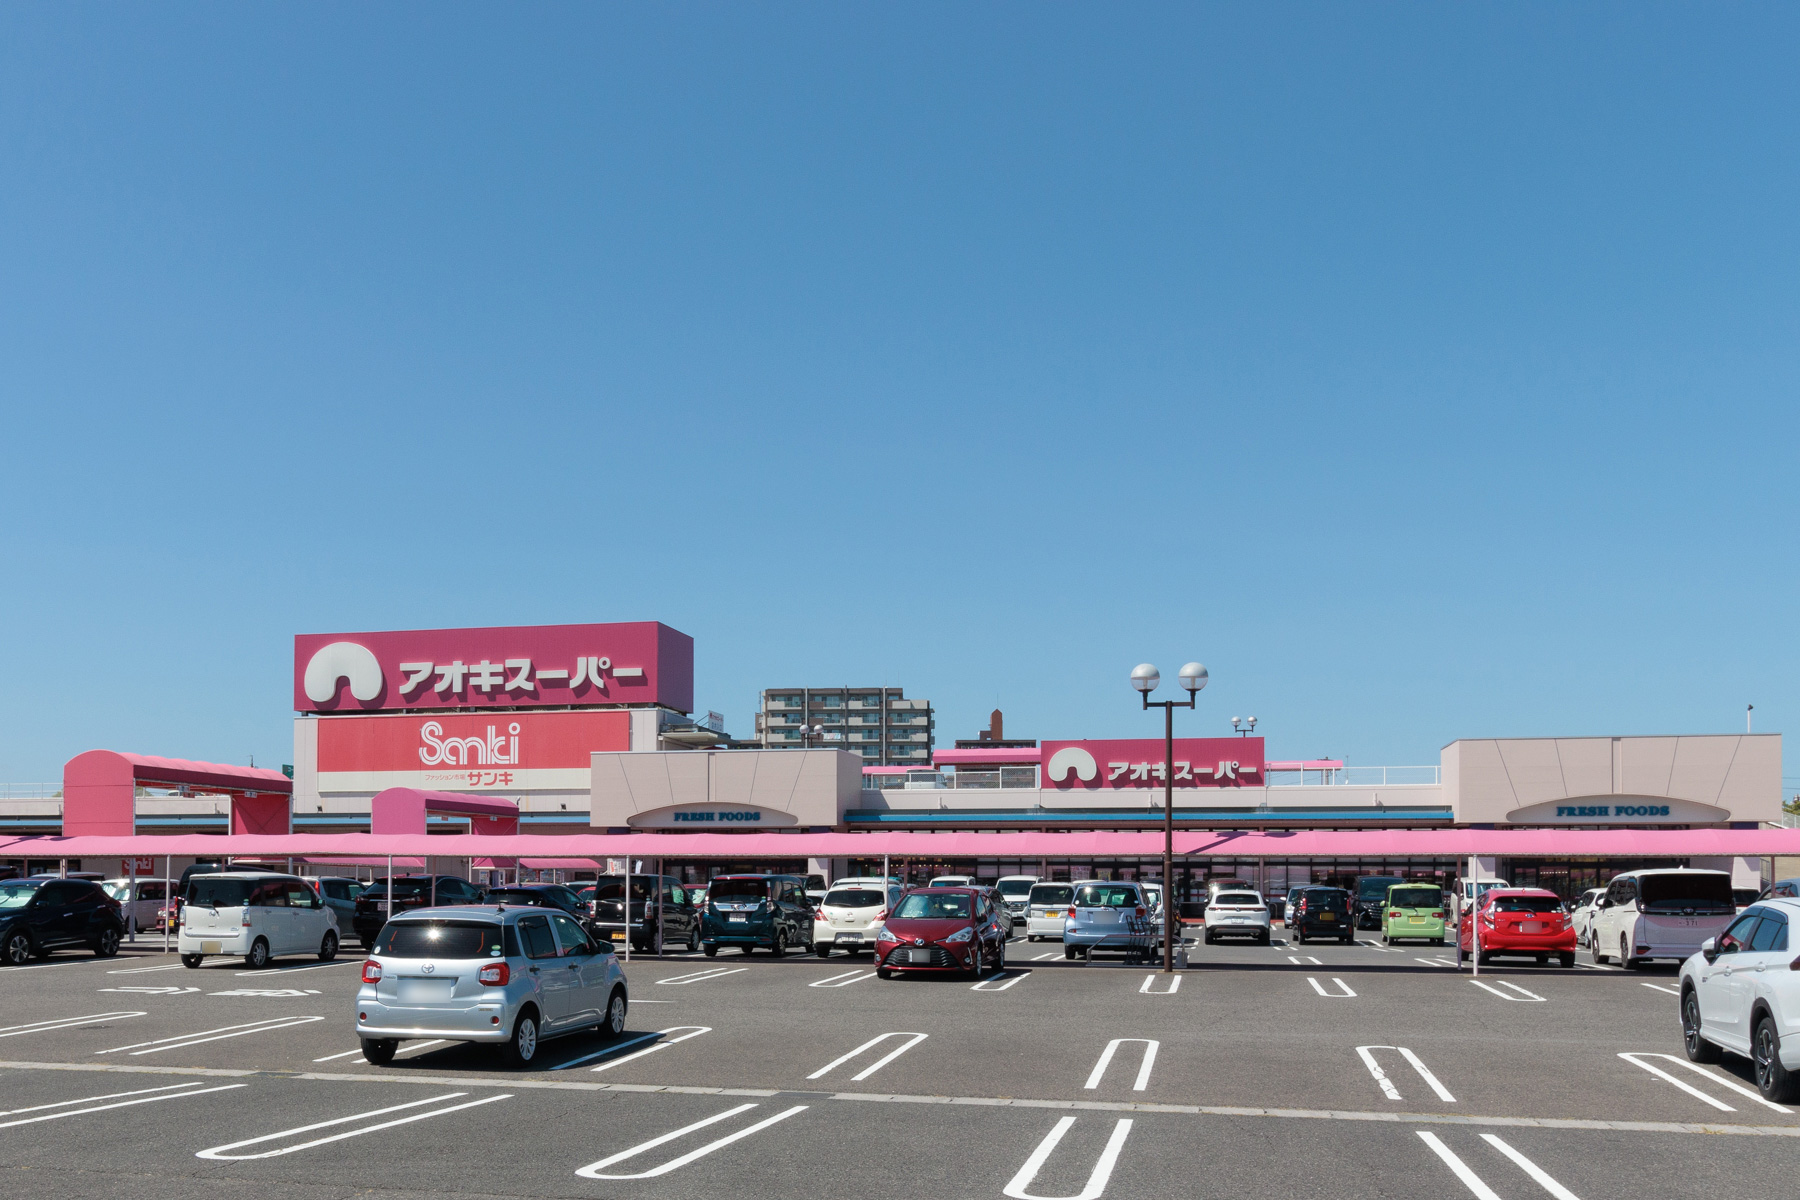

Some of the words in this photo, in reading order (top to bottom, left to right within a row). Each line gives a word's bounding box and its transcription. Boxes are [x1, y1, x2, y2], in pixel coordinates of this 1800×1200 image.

[399, 656, 643, 694] アオキスーパー
[418, 720, 521, 766] Sanki
[1107, 760, 1257, 781] アオキスーパー
[424, 773, 466, 781] ファッション市場
[467, 771, 513, 786] サンキ
[673, 811, 715, 822] FRESH
[718, 811, 761, 822] FOODS
[1556, 805, 1610, 817] FRESH
[1614, 805, 1670, 816] FOODS
[124, 856, 152, 870] Snki
